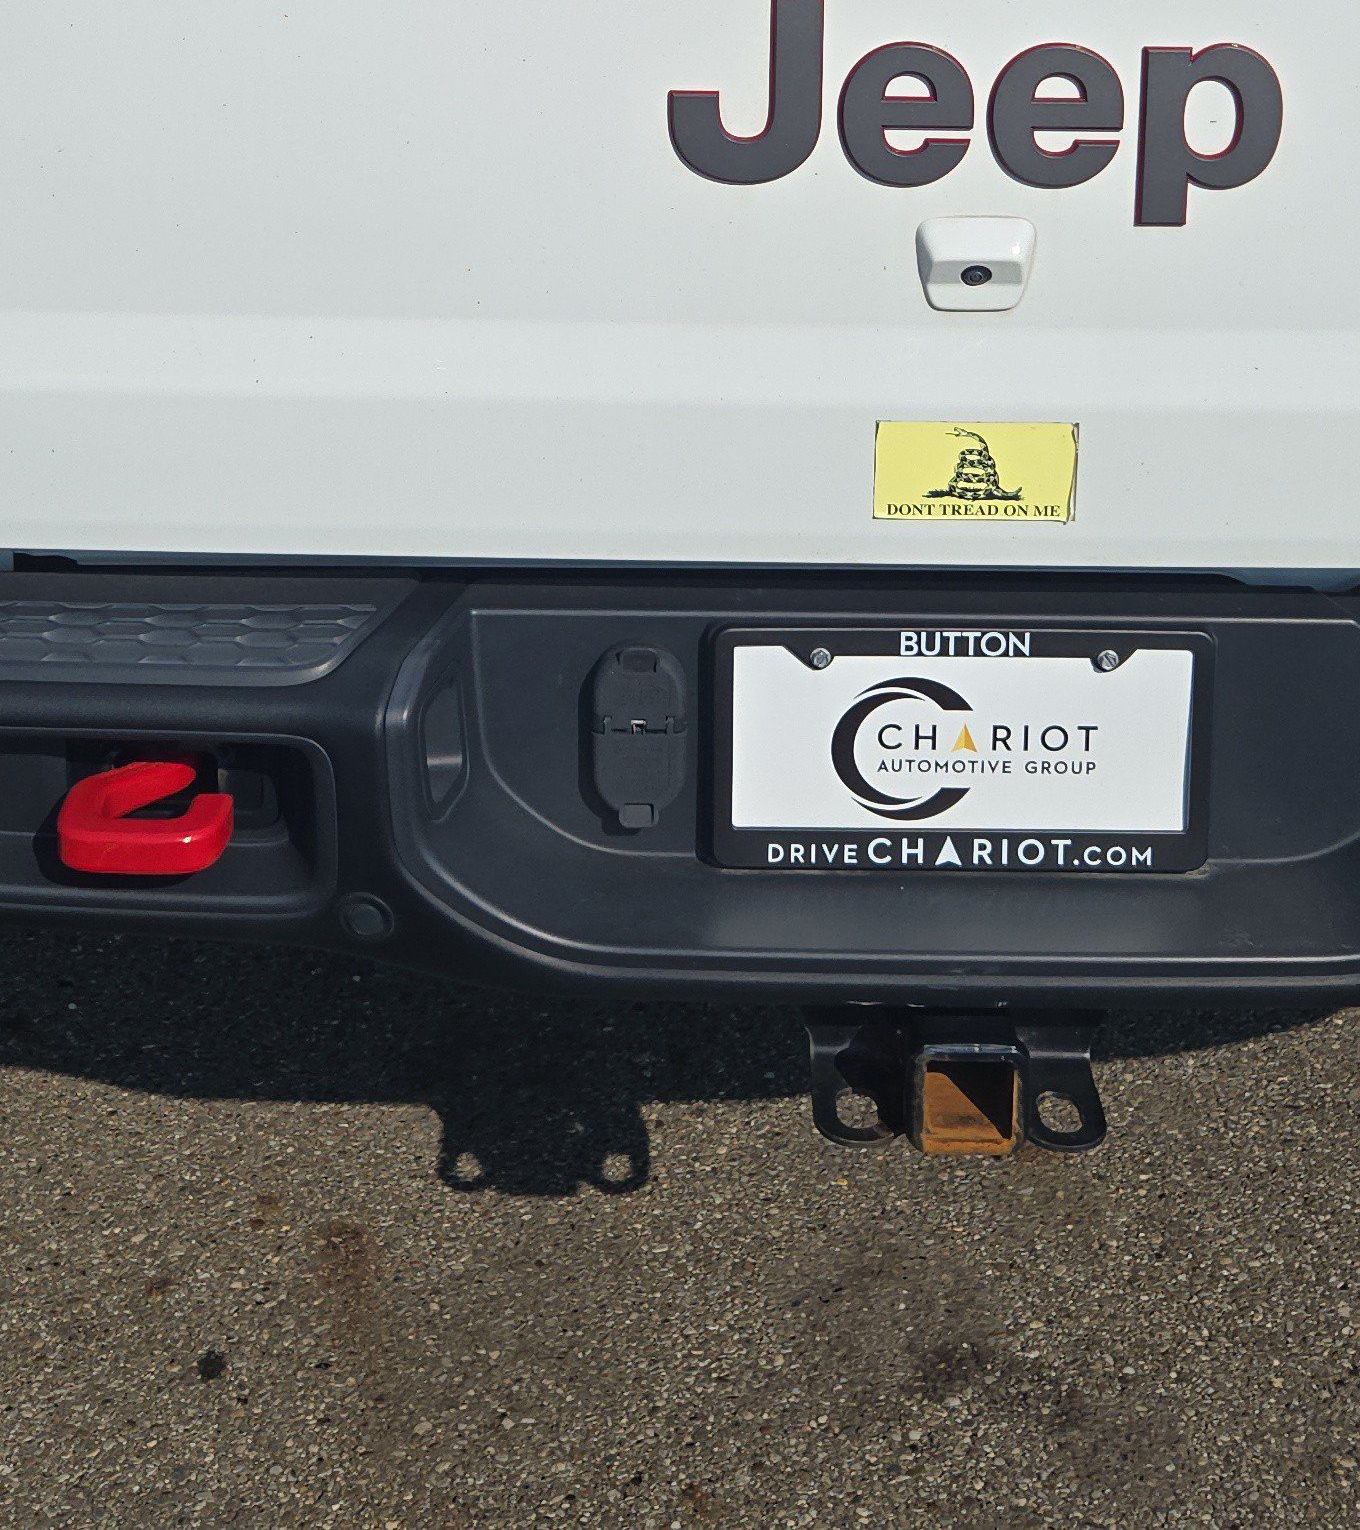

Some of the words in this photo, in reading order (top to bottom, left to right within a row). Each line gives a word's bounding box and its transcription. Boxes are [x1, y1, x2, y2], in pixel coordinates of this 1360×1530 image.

[886, 503, 936, 516] DONT
[939, 503, 999, 516] TREAD
[1003, 504, 1029, 517] ON
[1033, 504, 1060, 518] ME
[899, 631, 1031, 657] BUTTON
[877, 722, 1099, 754] CHARIOT
[876, 758, 1013, 775] AUTOMOTIVE
[1024, 759, 1098, 776] GROUP
